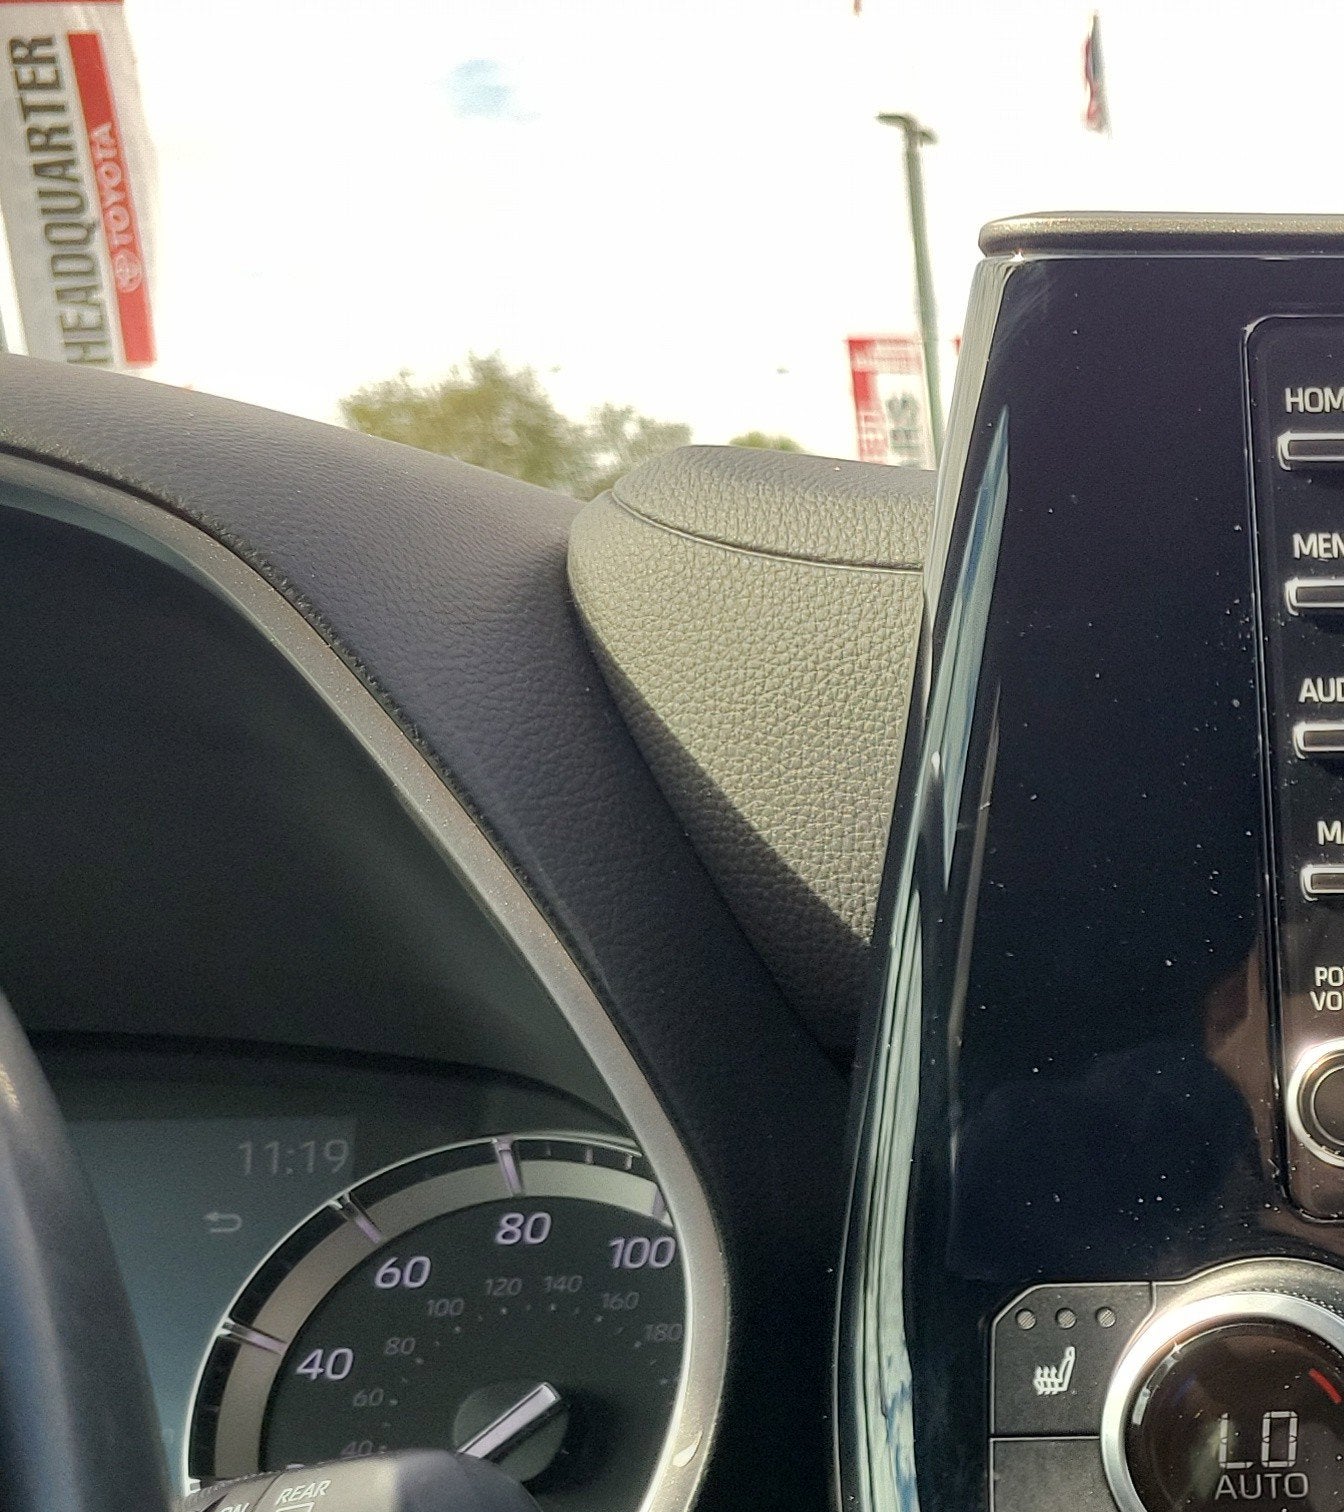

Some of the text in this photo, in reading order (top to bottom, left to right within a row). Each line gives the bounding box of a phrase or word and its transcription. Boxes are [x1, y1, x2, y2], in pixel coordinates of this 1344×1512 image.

[8, 33, 114, 365] HEADQUARTER
[90, 122, 132, 248] TOYOTA
[238, 1138, 349, 1177] 11:19
[495, 1211, 553, 1246] 80
[608, 1236, 678, 1270] 100
[374, 1255, 432, 1290] 60
[485, 1277, 523, 1298] 120
[426, 1298, 465, 1318] 100
[602, 1291, 640, 1311] 160
[384, 1337, 416, 1356] 80
[297, 1347, 355, 1383] 40
[352, 1388, 384, 1408] 60
[276, 1480, 332, 1505] REAR
[1214, 1473, 1309, 1501] AUTO
